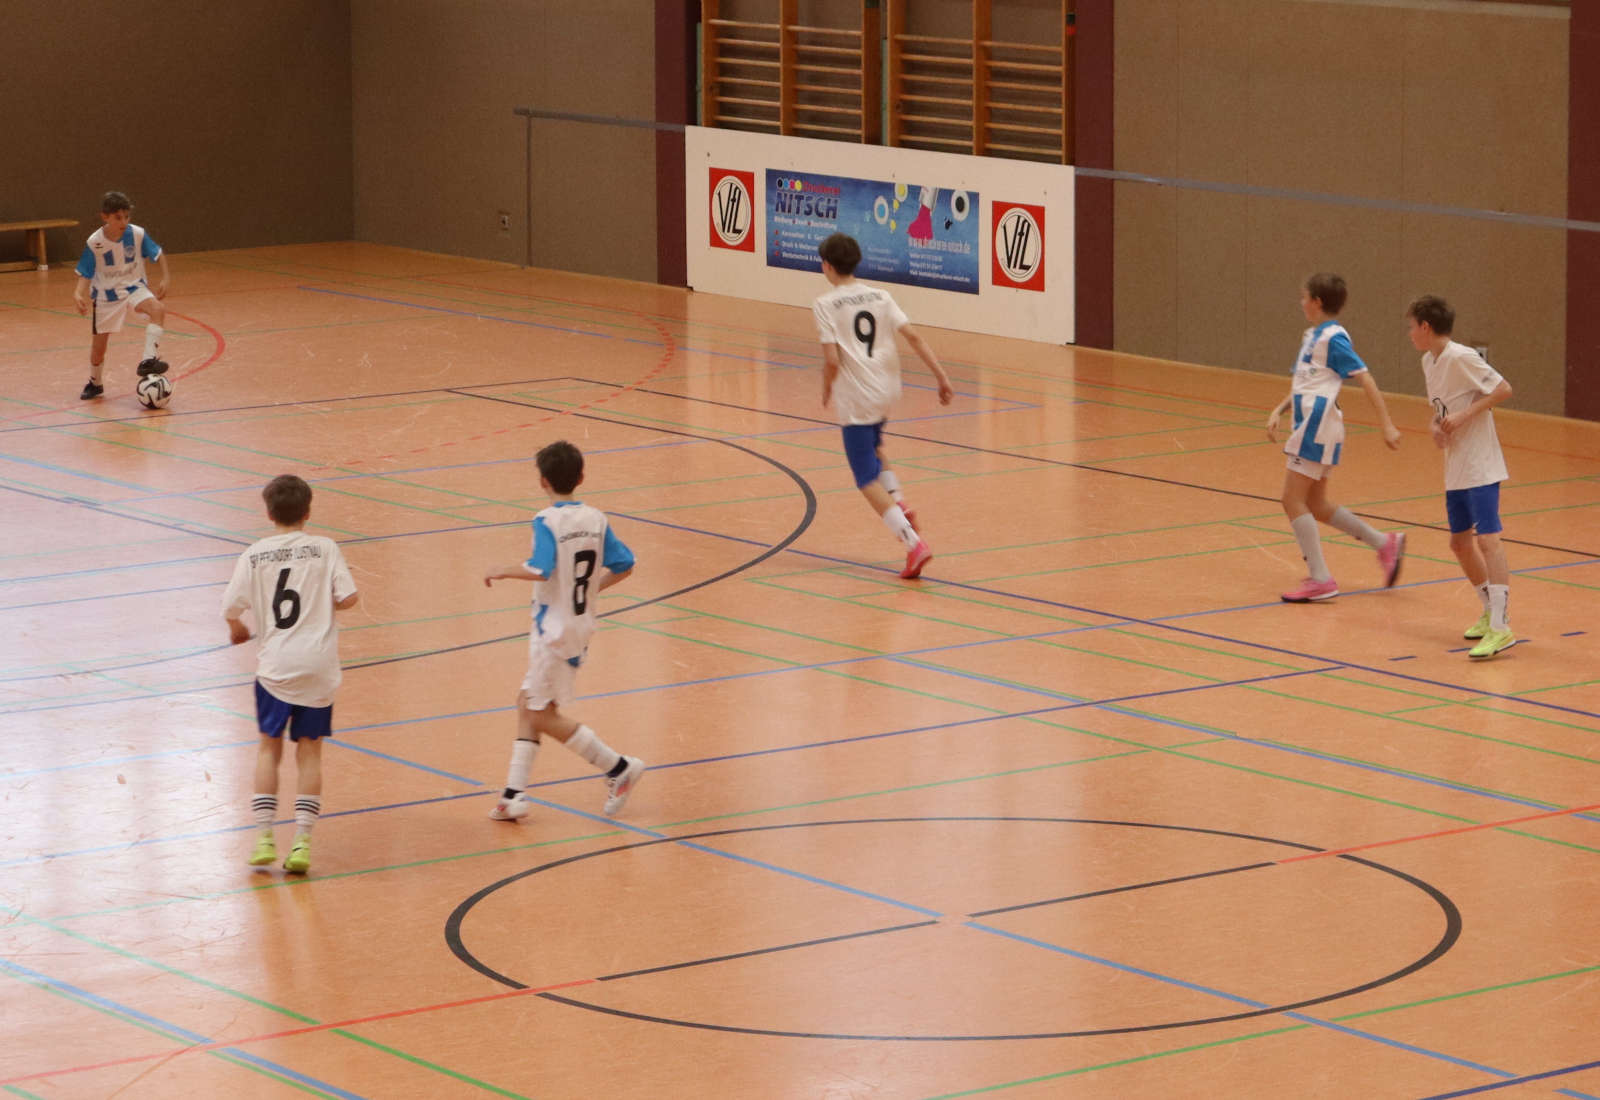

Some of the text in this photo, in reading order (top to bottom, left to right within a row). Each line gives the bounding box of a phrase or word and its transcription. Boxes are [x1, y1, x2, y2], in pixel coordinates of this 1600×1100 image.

[717, 182, 745, 233] VfL
[775, 191, 839, 219] NITSCH
[1003, 214, 1032, 270] VfL
[854, 310, 876, 358] 9
[272, 567, 301, 630] 6
[573, 549, 597, 616] 8
